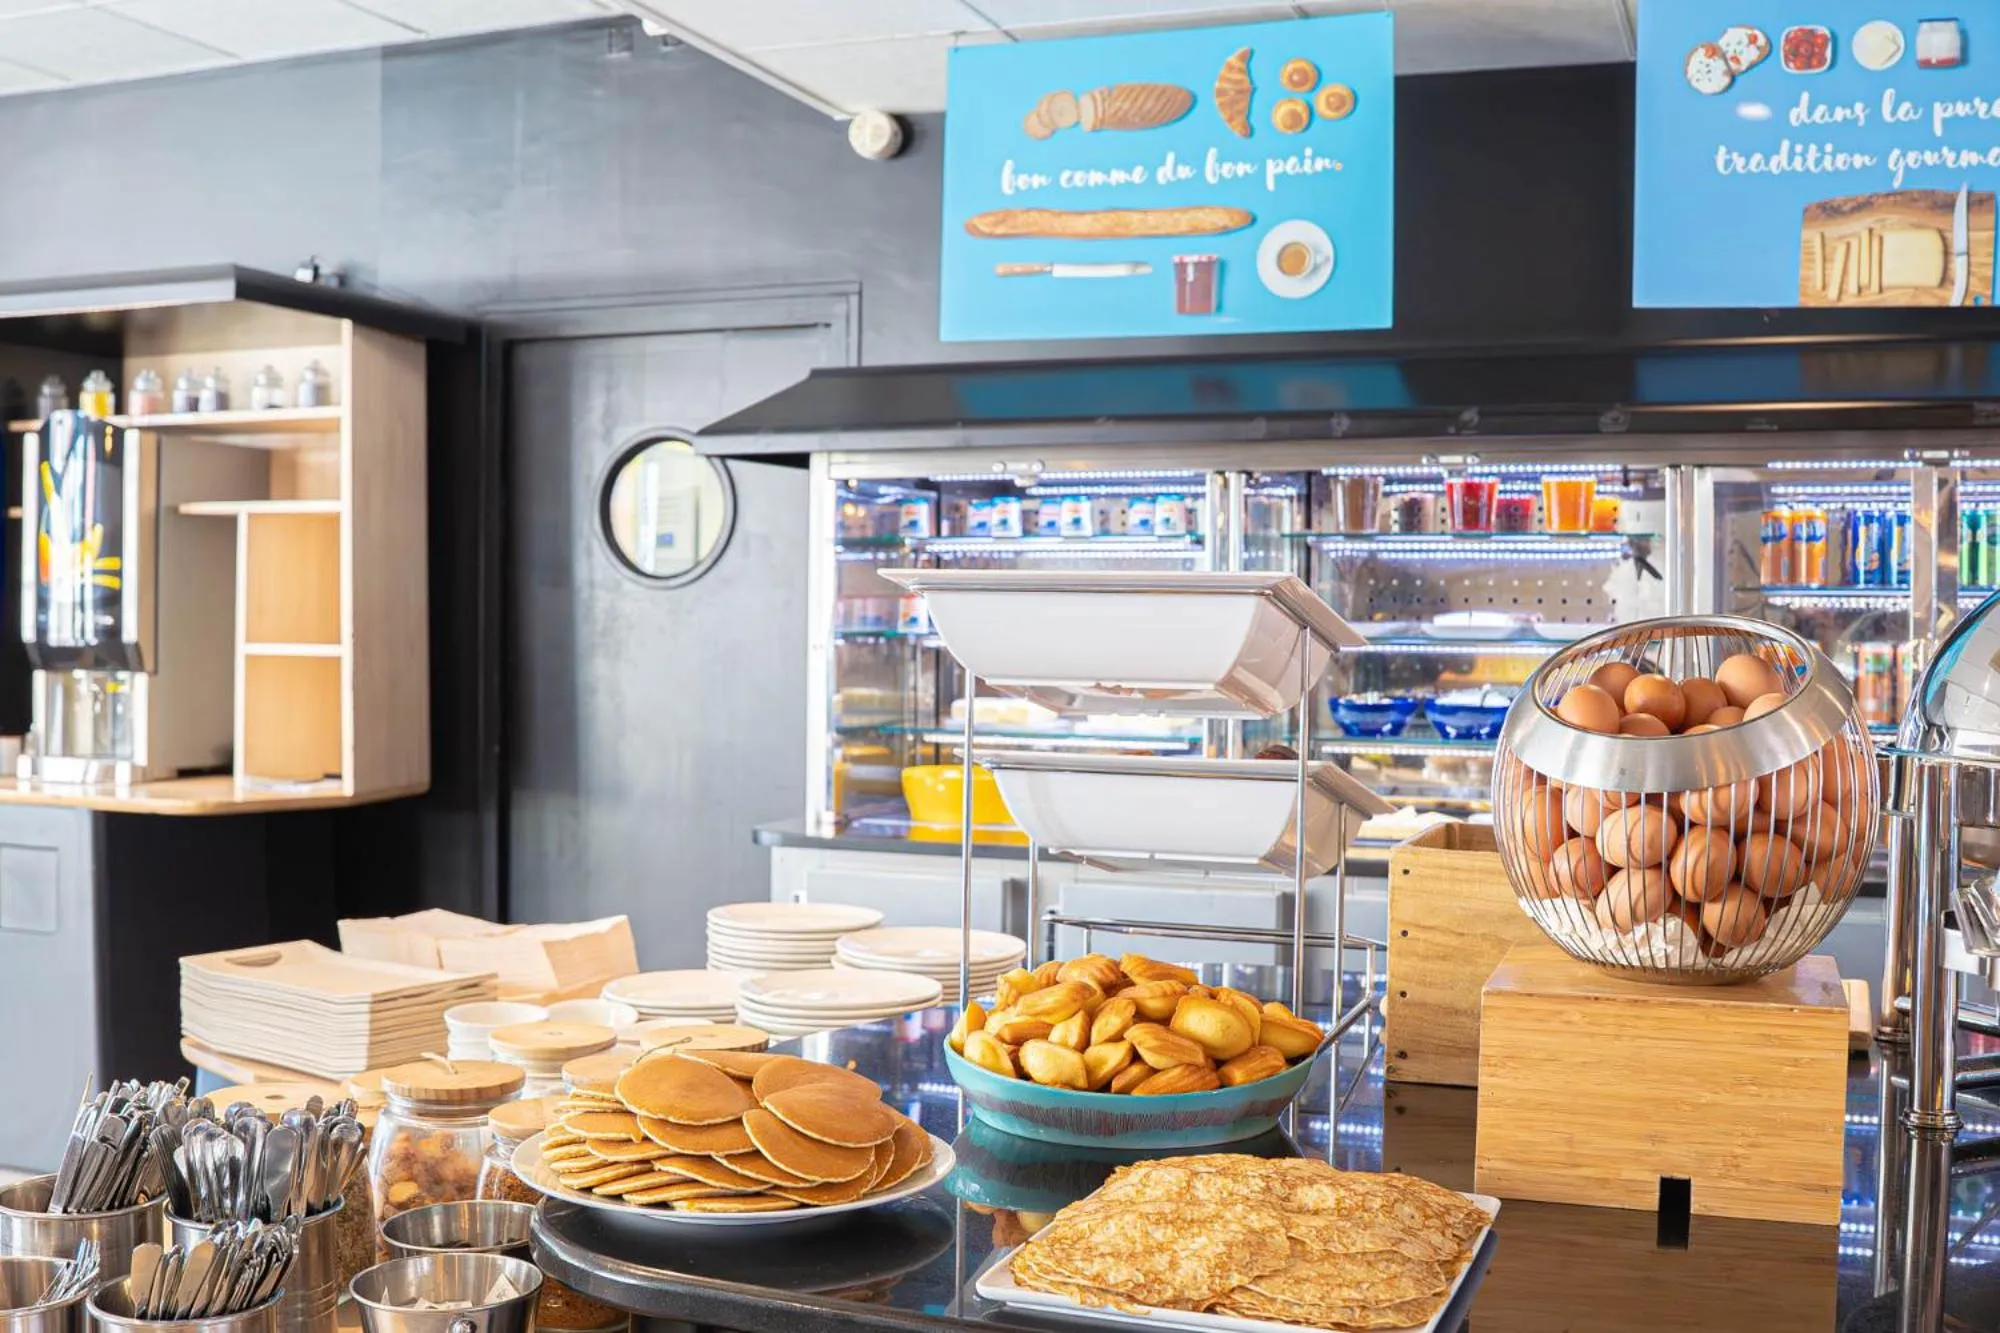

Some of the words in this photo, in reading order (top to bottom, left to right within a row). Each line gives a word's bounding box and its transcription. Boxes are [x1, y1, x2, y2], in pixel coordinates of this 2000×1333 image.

[1790, 91, 1870, 127] dans
[1882, 88, 1923, 123] la
[1001, 159, 1051, 195] bon
[1059, 163, 1148, 189] comme
[1156, 151, 1196, 185] du
[1204, 147, 1257, 185] bon
[1265, 147, 1343, 192] pain.
[1715, 138, 1877, 175] tradition
